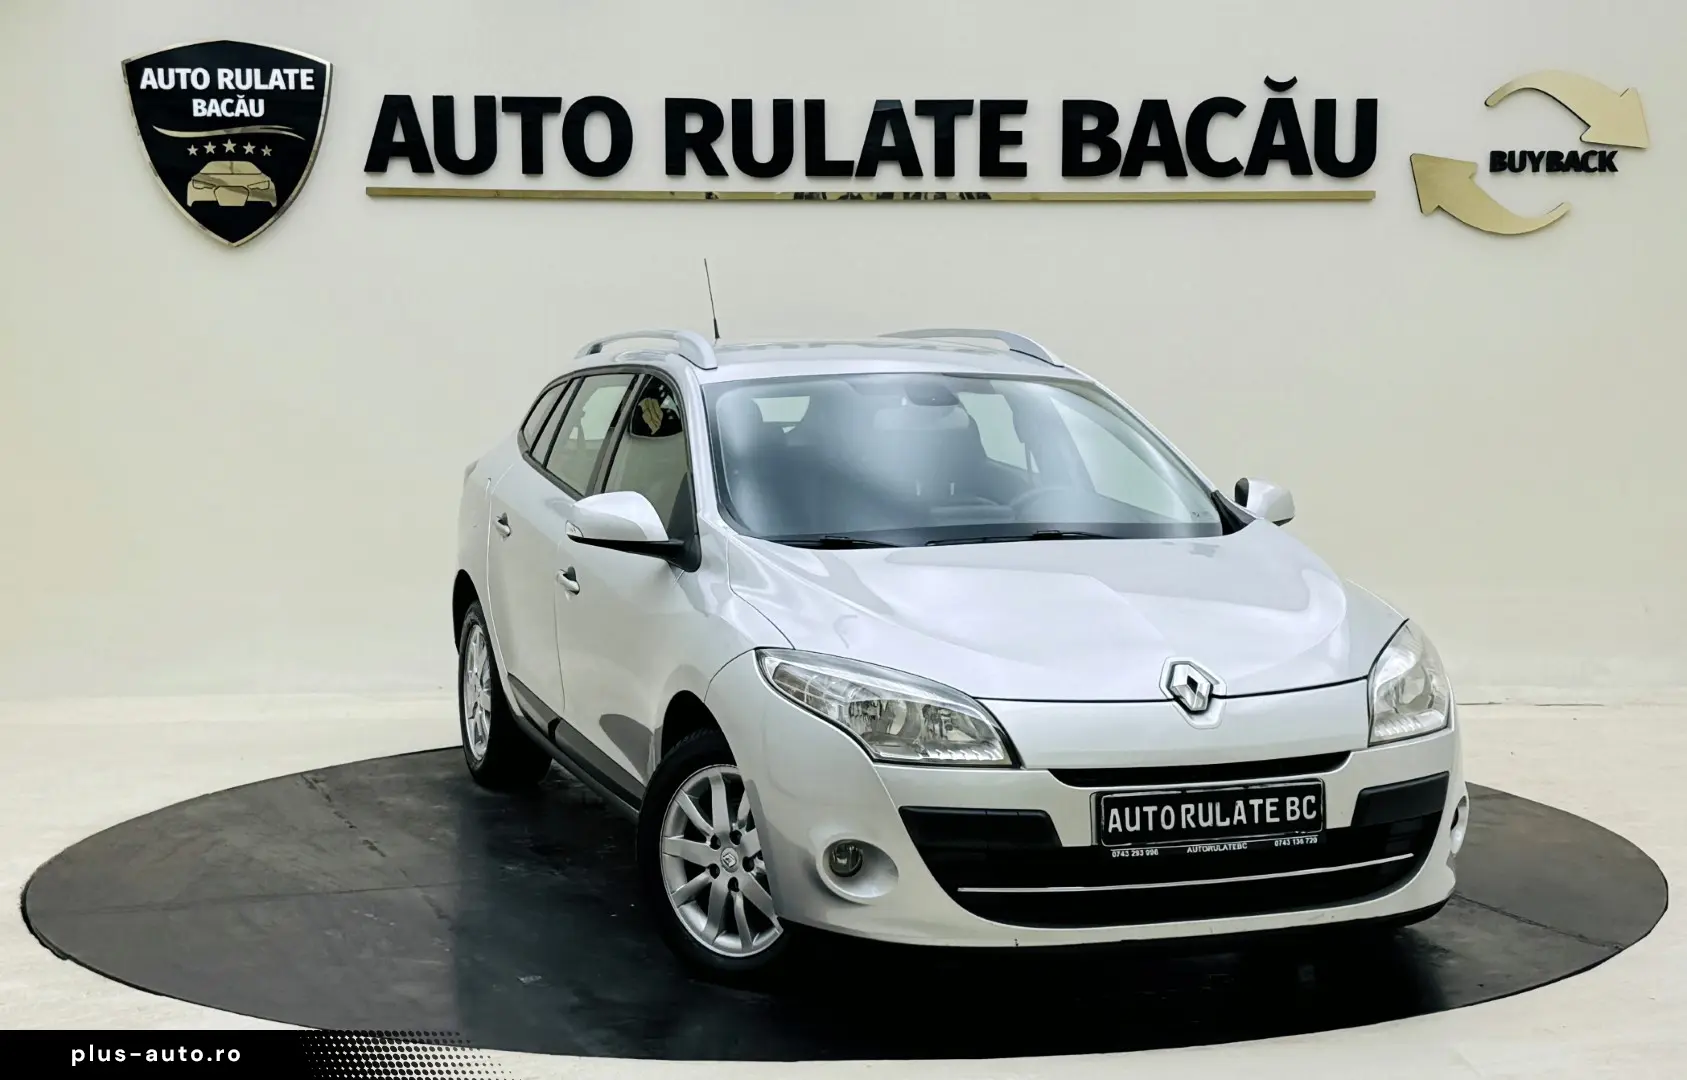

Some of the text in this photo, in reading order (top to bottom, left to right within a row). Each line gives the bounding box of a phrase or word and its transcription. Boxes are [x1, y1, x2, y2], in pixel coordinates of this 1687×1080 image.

[140, 67, 315, 91] AUTO RULATE
[192, 94, 265, 118] BACĂU
[364, 76, 1379, 179] AUTO RULATE BACĂU
[1108, 795, 1317, 833] AUTO RULATE BC
[1112, 850, 1129, 858] 0743
[1274, 838, 1290, 847] 0743
